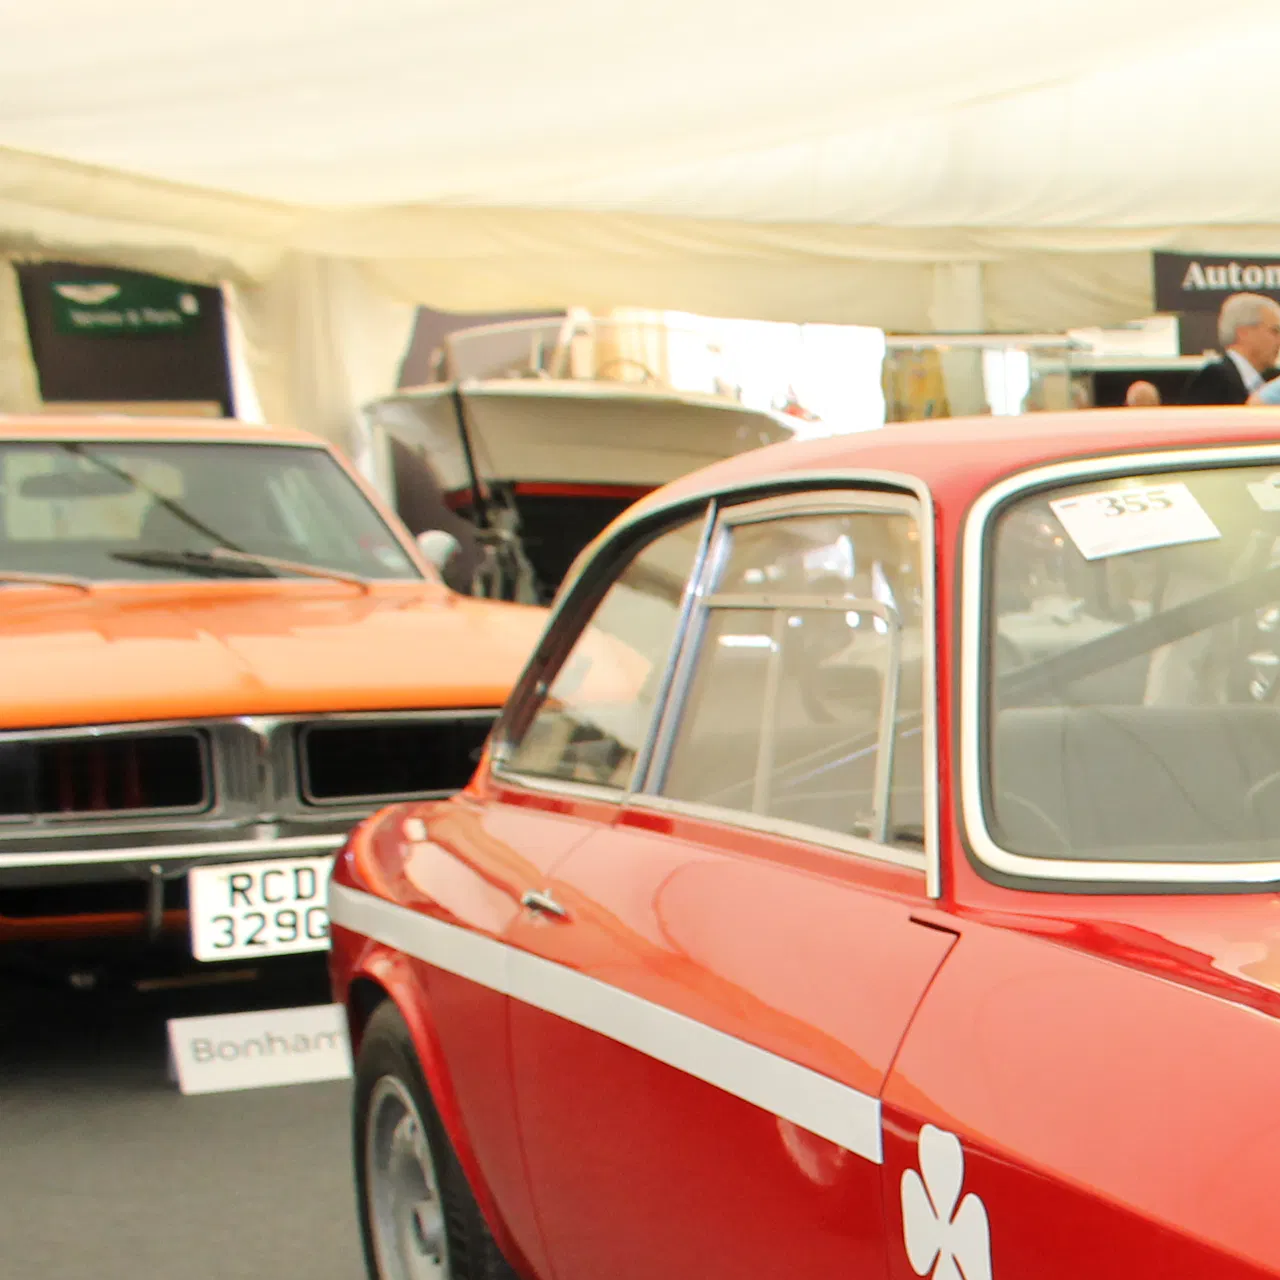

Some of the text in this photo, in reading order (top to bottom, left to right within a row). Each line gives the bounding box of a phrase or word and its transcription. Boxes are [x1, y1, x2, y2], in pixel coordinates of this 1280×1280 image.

[1099, 490, 1173, 517] 355
[228, 867, 317, 907] RCD
[191, 1030, 340, 1063] Bonham
